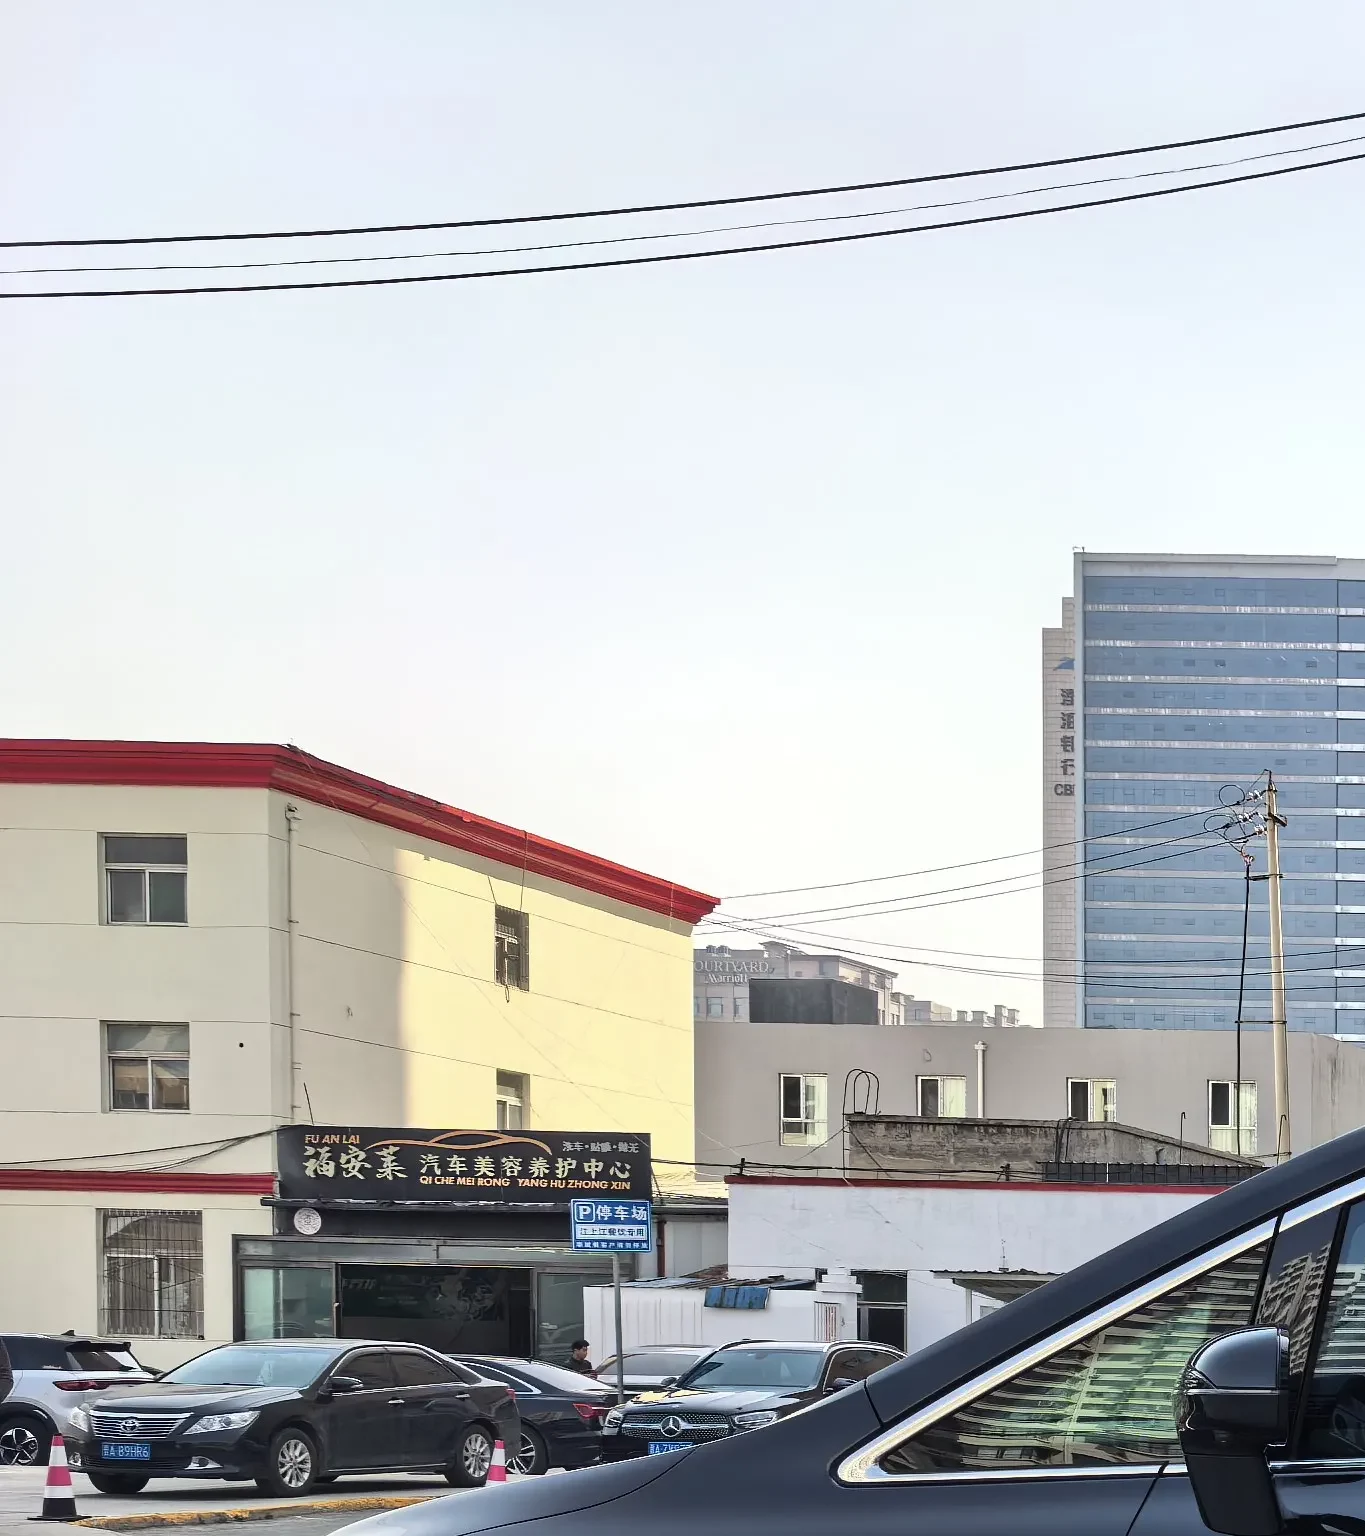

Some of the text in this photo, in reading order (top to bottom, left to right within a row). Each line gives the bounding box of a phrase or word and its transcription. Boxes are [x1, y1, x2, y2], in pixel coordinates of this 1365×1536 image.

[695, 960, 769, 973] OURTYARD
[305, 1134, 361, 1145] FU AN LAI
[419, 1154, 632, 1180] 汽车美容养护中心
[419, 1176, 631, 1190] QI CHE MEI RONG YANG HU ZHONG XIN
[596, 1204, 648, 1221] 停车场
